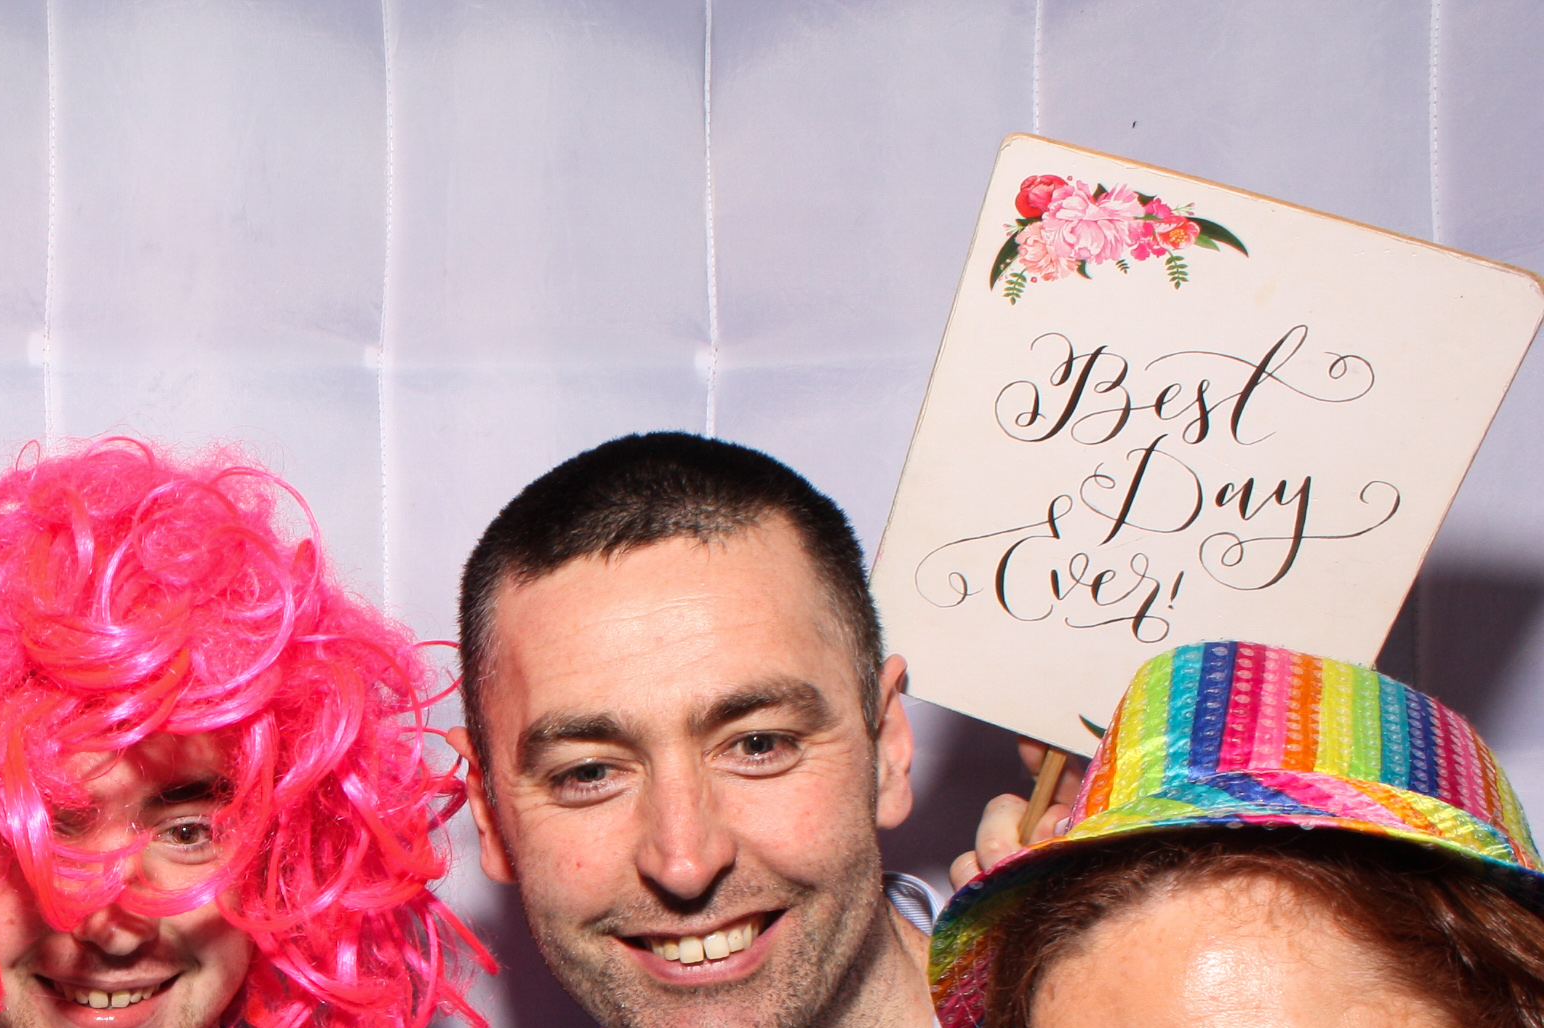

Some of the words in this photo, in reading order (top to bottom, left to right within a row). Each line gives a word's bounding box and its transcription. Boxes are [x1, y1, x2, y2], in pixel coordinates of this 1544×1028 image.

[995, 325, 1375, 446] Best
[915, 494, 1185, 644] Ever!
[1080, 433, 1401, 591] Day
